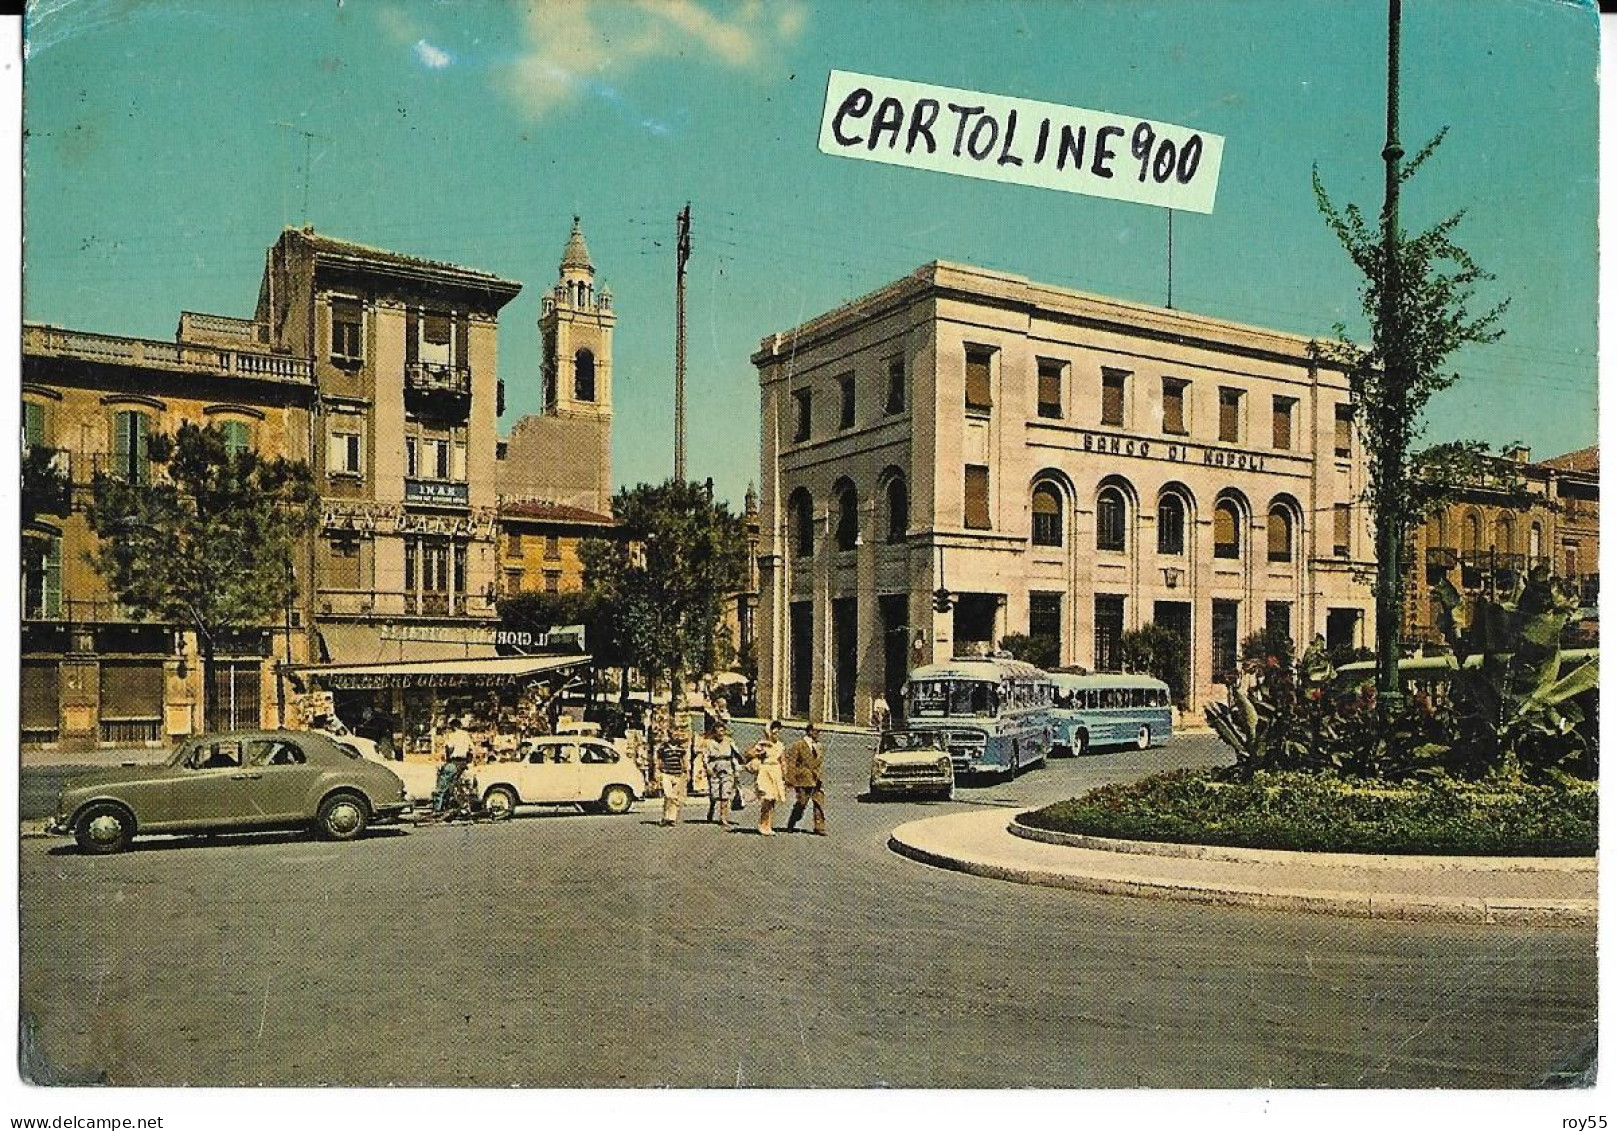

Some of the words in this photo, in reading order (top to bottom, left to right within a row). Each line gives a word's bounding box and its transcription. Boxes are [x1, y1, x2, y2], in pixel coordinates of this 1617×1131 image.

[1084, 433, 1150, 457] BANCO
[1168, 445, 1187, 462] DI
[1203, 450, 1265, 470] NAPOLI
